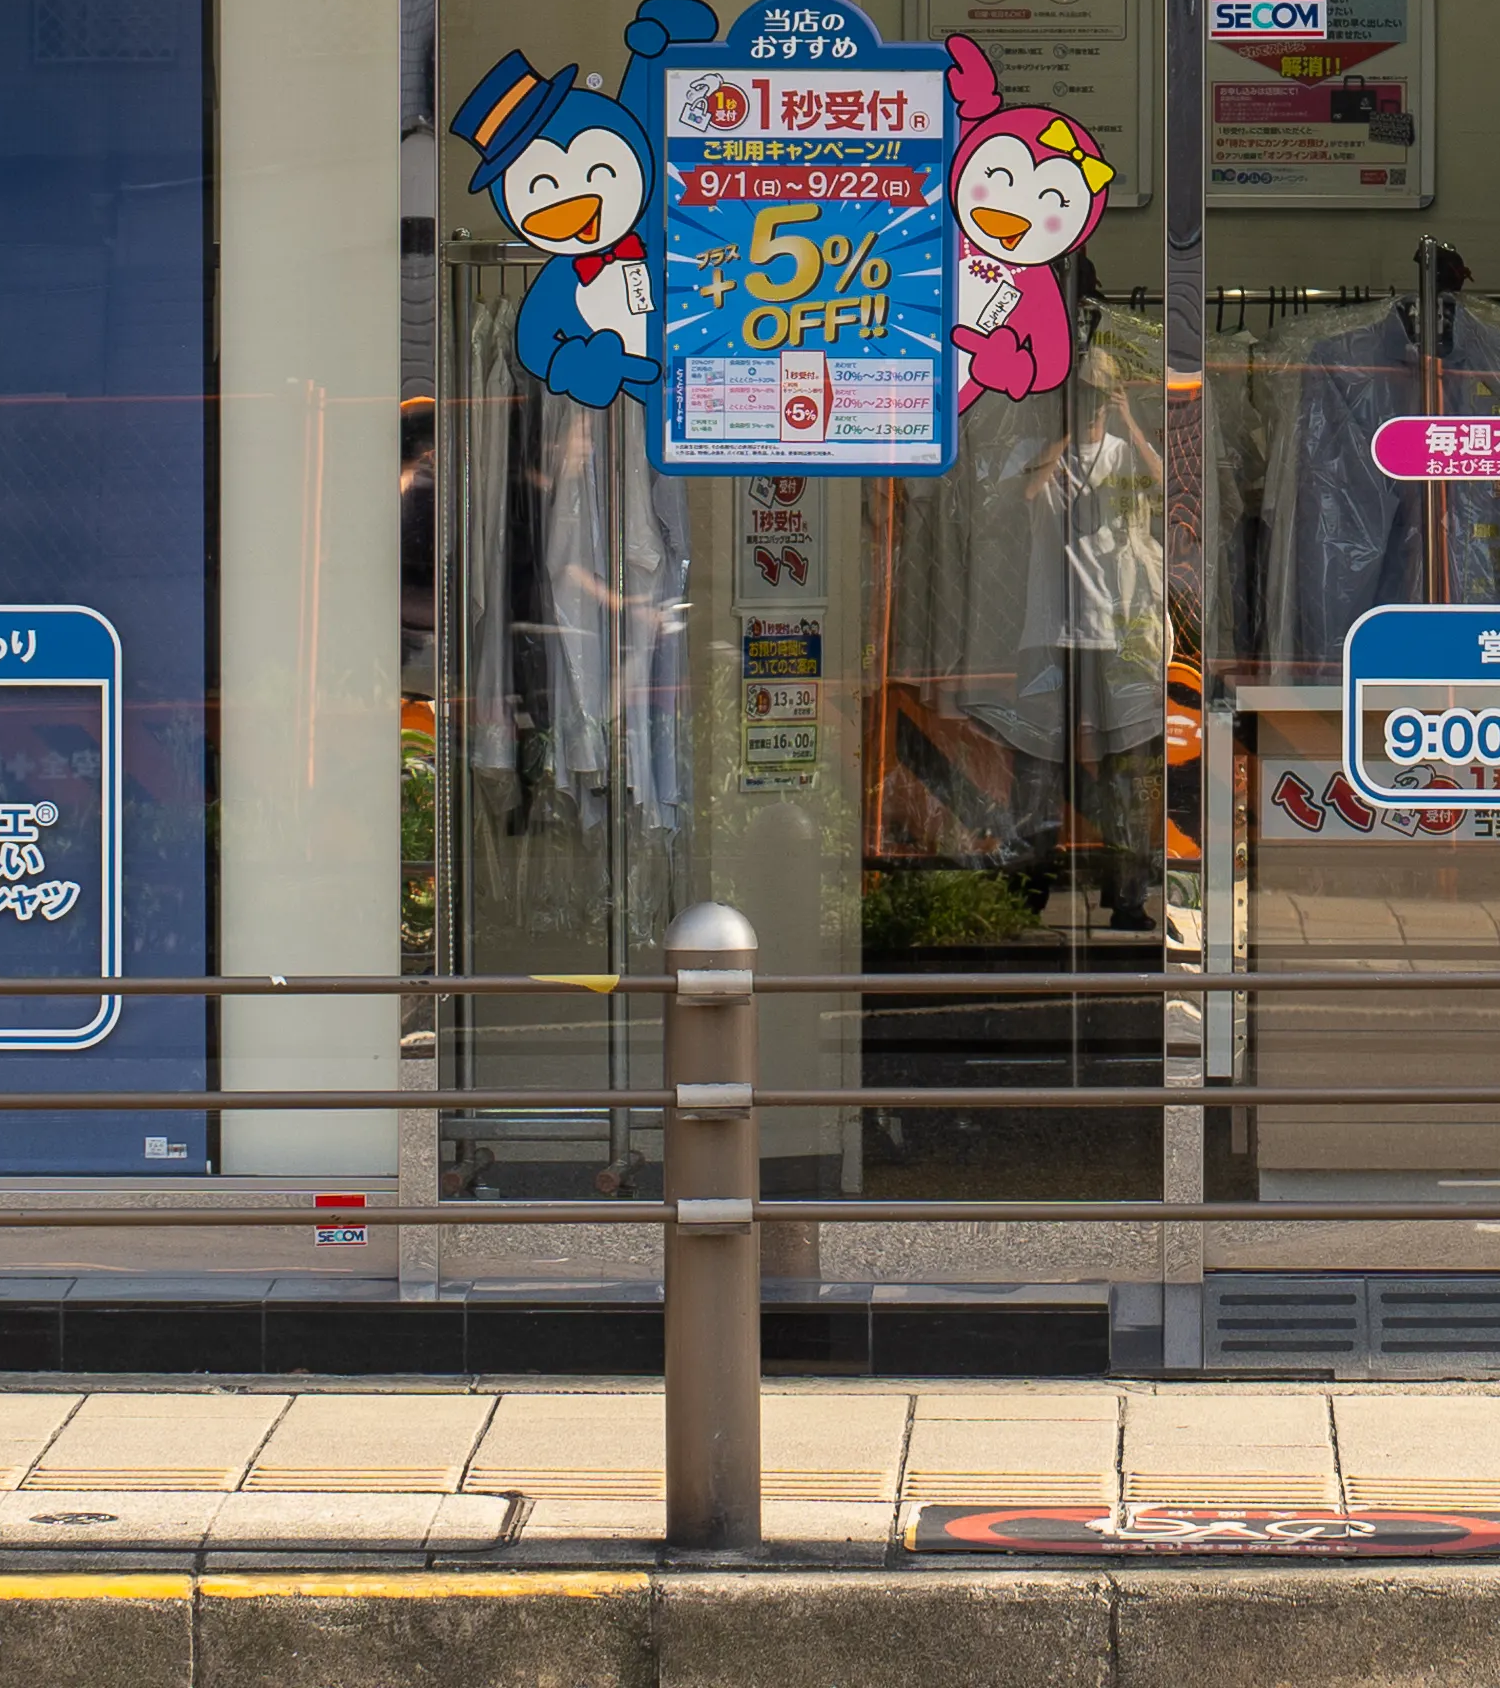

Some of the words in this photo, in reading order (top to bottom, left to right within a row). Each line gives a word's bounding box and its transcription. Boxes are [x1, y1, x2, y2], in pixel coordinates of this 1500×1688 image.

[764, 9, 845, 32] 当店の
[1216, 3, 1319, 29] SECOM
[750, 36, 858, 59] おすすめ
[696, 243, 740, 269] プラス
[742, 293, 889, 350] OFF!!
[317, 1229, 365, 1242] SECOM
